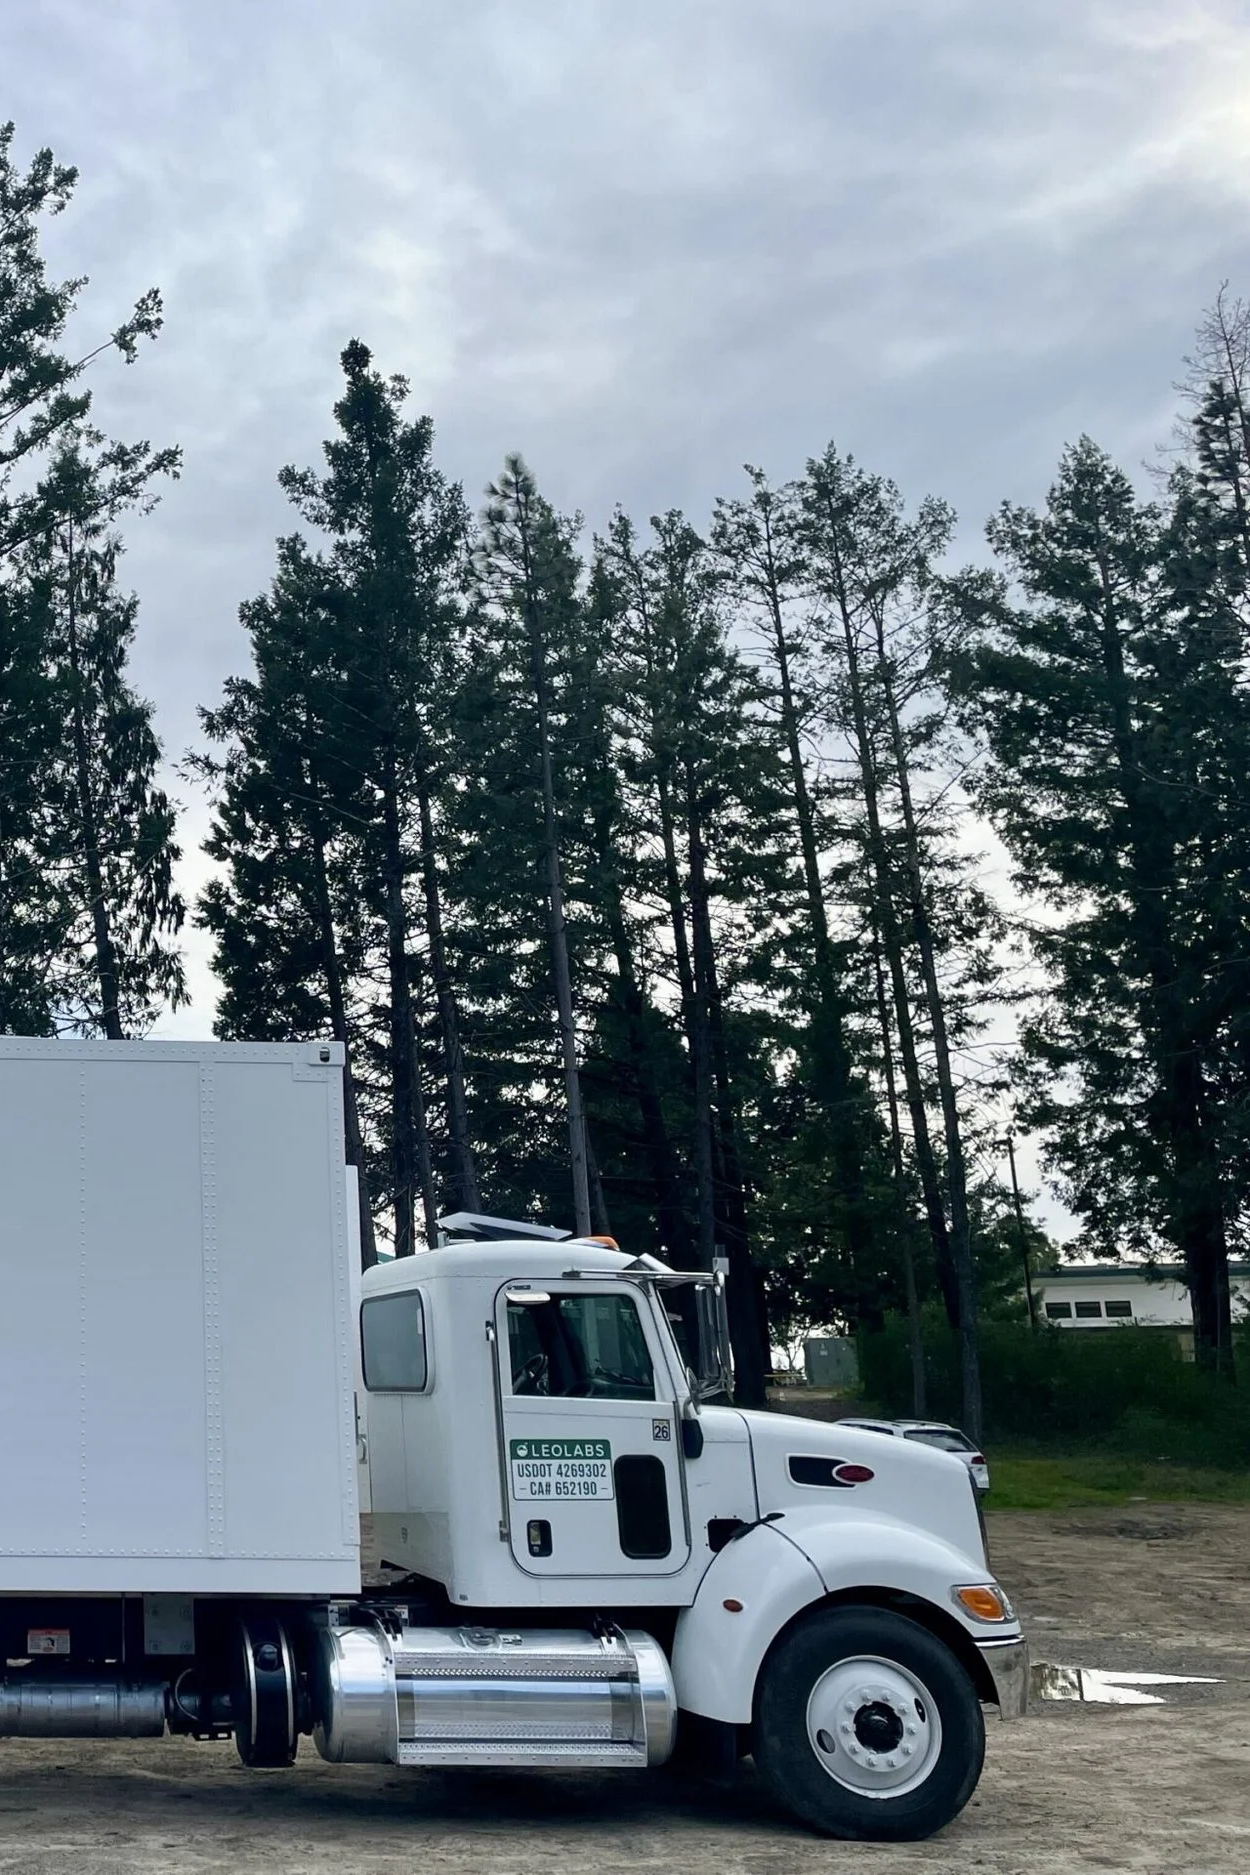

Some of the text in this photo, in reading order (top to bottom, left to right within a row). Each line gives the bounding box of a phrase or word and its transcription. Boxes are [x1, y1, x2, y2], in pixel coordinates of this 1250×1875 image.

[654, 1425, 669, 1439] 26
[531, 1444, 605, 1457] LEOLABS
[517, 1463, 607, 1478] USDOT 4269302
[530, 1481, 597, 1496] CA# 652190
